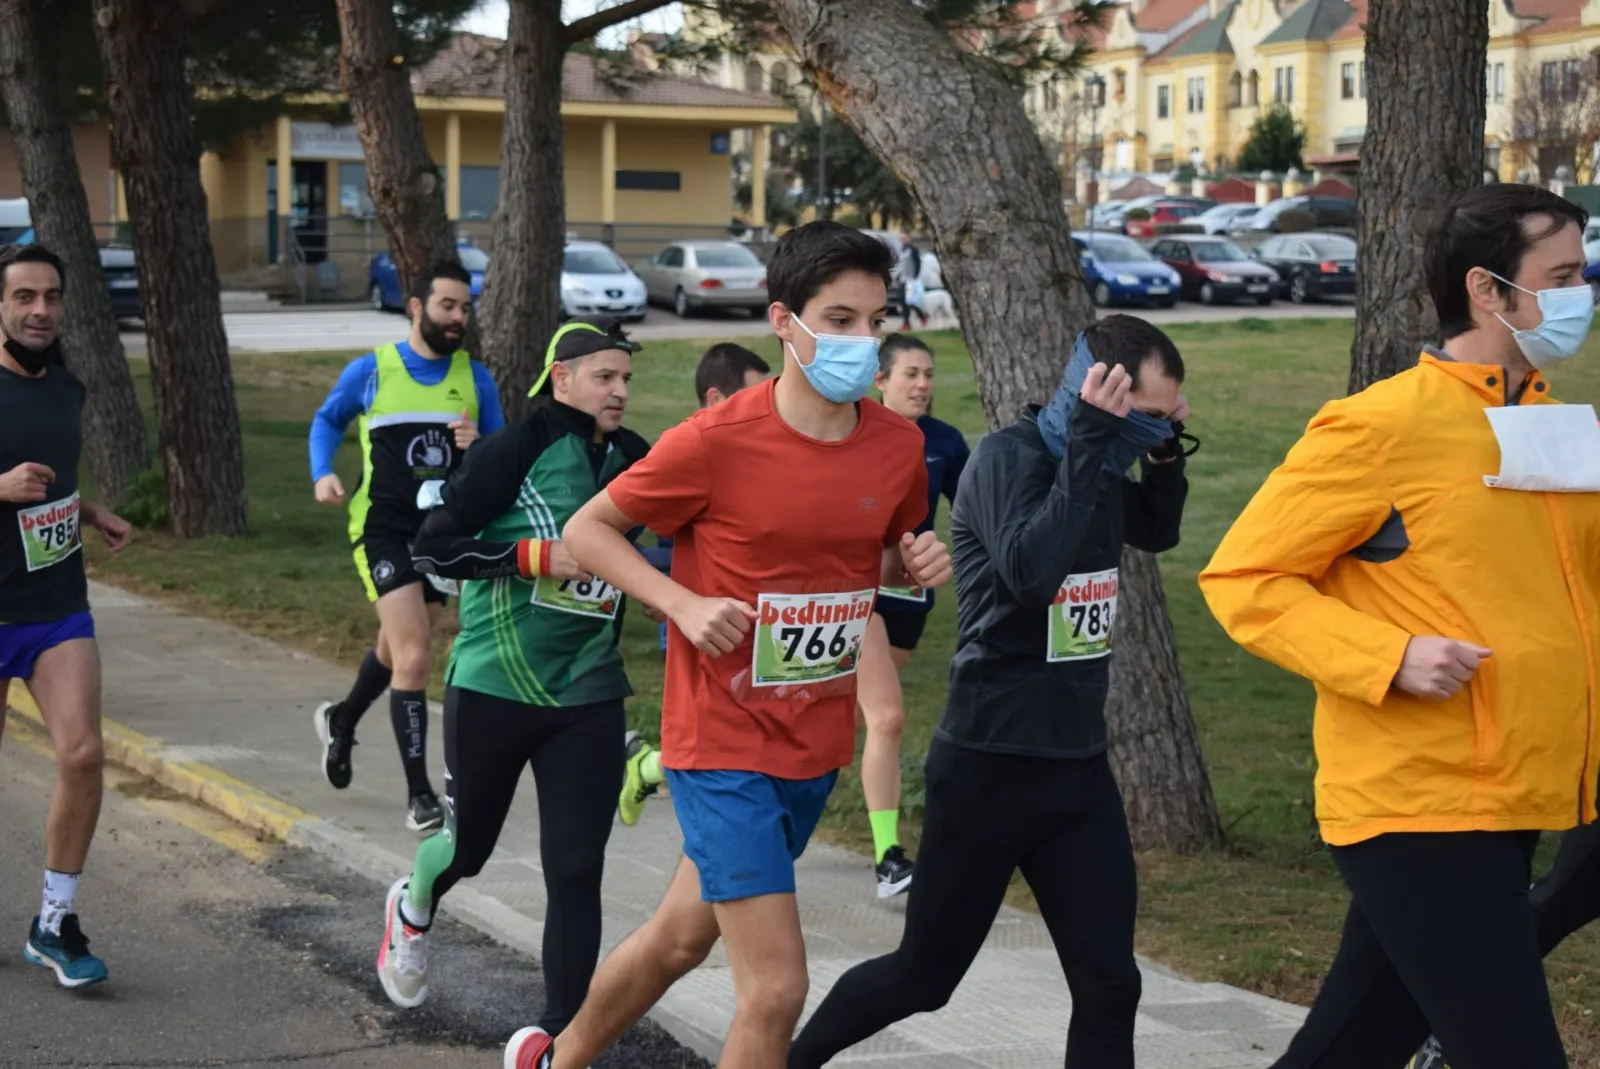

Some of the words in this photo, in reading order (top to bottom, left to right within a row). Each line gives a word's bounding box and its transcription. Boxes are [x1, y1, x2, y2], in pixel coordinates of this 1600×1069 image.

[39, 517, 74, 552] 785
[760, 598, 870, 626] bedunia
[1070, 601, 1110, 639] 783
[781, 624, 847, 662] 766
